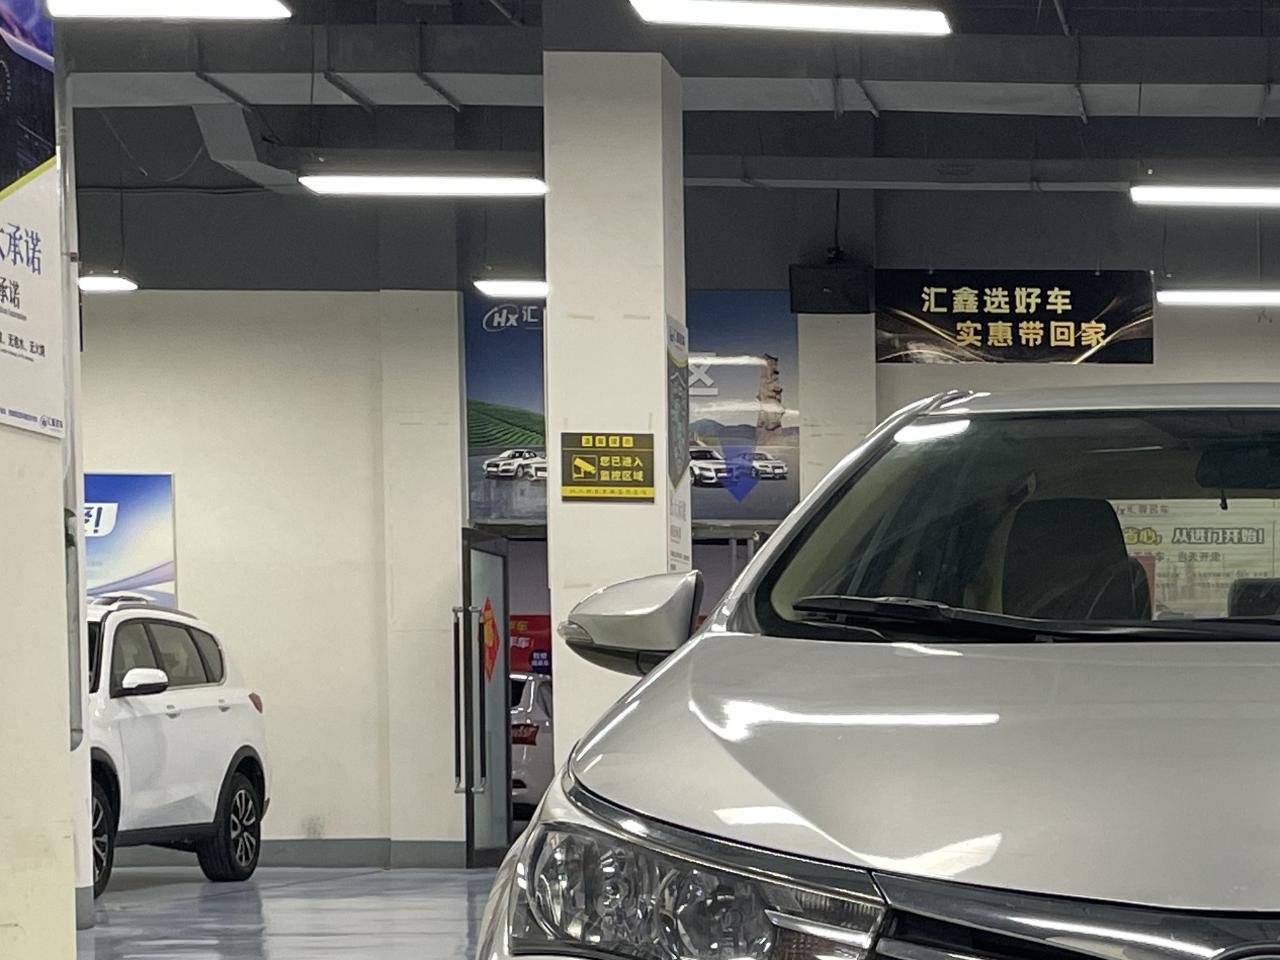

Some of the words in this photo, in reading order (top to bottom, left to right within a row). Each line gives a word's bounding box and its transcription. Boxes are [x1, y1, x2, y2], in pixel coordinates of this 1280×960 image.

[920, 286, 1073, 315] 汇鑫选好车
[956, 320, 1108, 348] 实惠带回家
